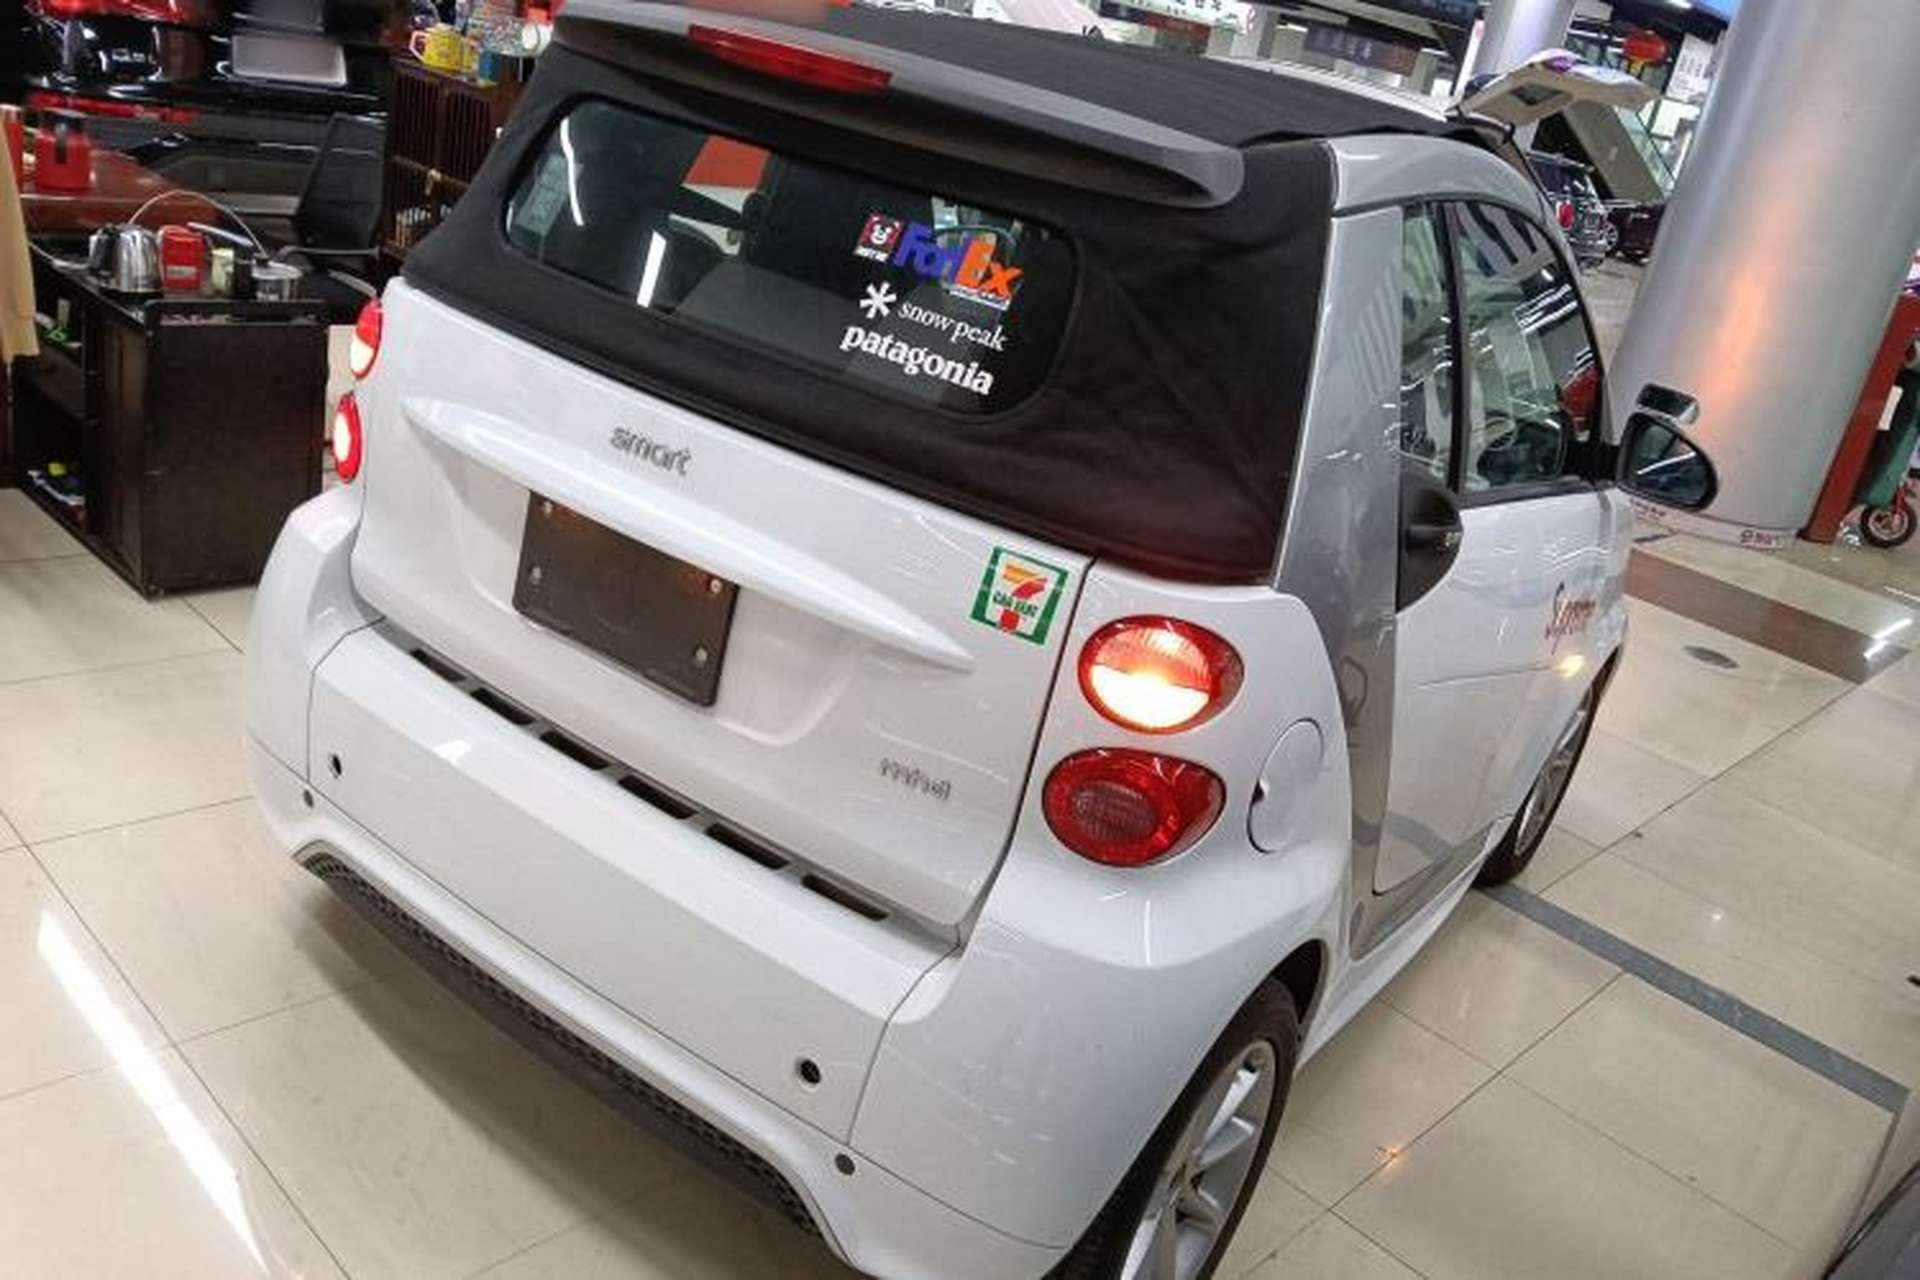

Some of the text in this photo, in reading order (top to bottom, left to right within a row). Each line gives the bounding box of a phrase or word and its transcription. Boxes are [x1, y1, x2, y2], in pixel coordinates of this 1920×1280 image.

[892, 222, 1024, 298] FedEx
[898, 302, 1008, 351] snow peak
[839, 326, 994, 395] patagonia
[611, 427, 692, 477] smart
[880, 757, 951, 801] mhd
